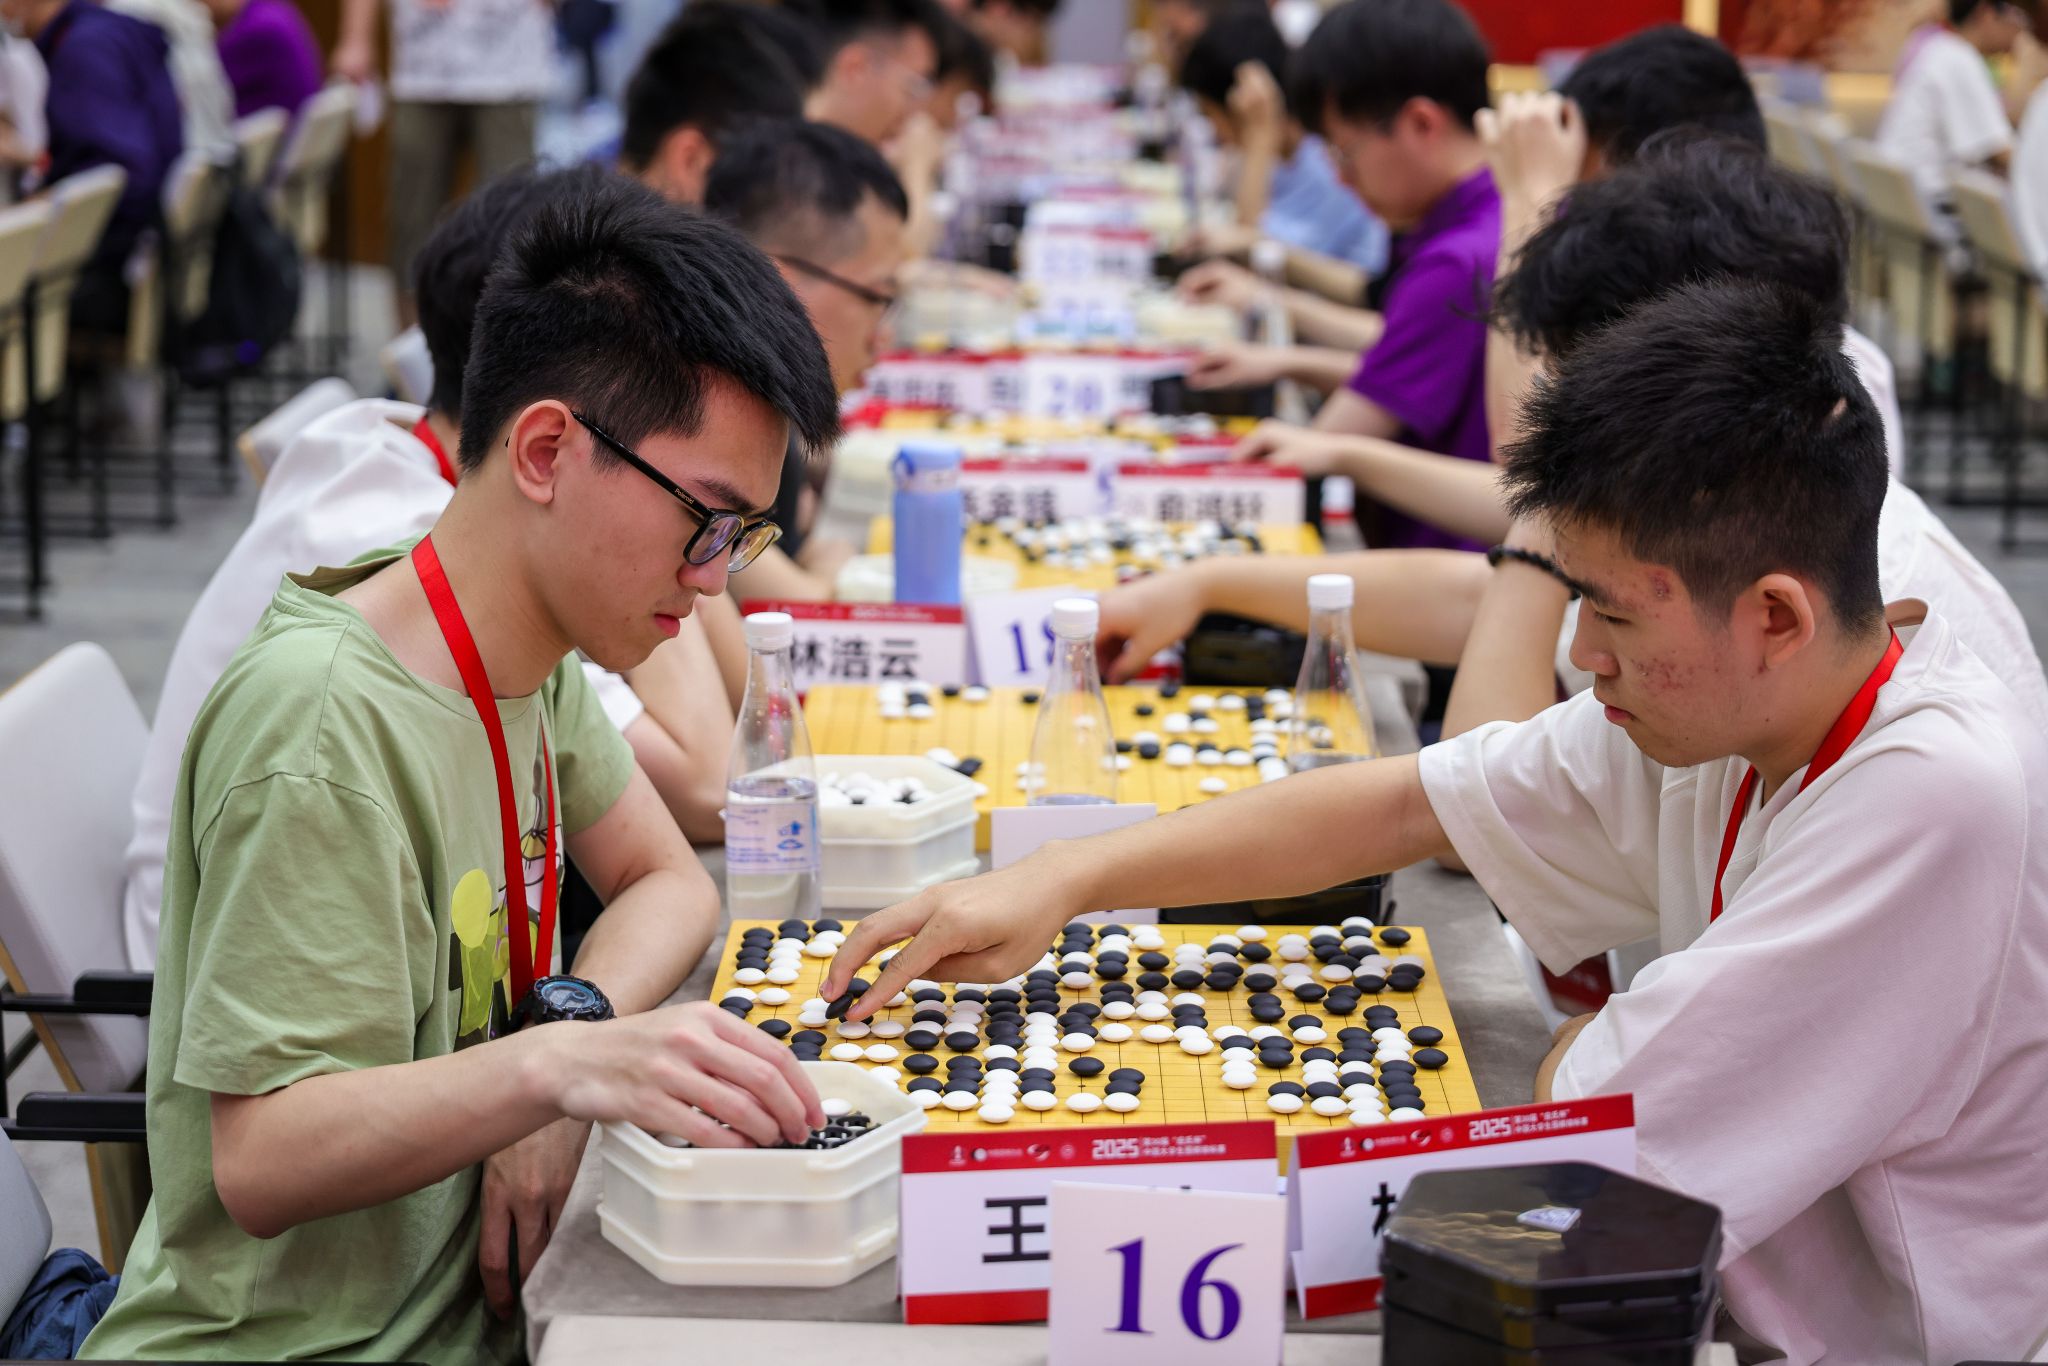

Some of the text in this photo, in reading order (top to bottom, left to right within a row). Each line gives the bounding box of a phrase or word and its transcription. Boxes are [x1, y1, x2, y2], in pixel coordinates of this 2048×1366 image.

[789, 635, 919, 678] 林浩云
[1092, 1138, 1139, 1159] 2025
[1468, 1117, 1511, 1141] 2025
[982, 1196, 1051, 1264] 王
[1104, 1236, 1246, 1341] 16
